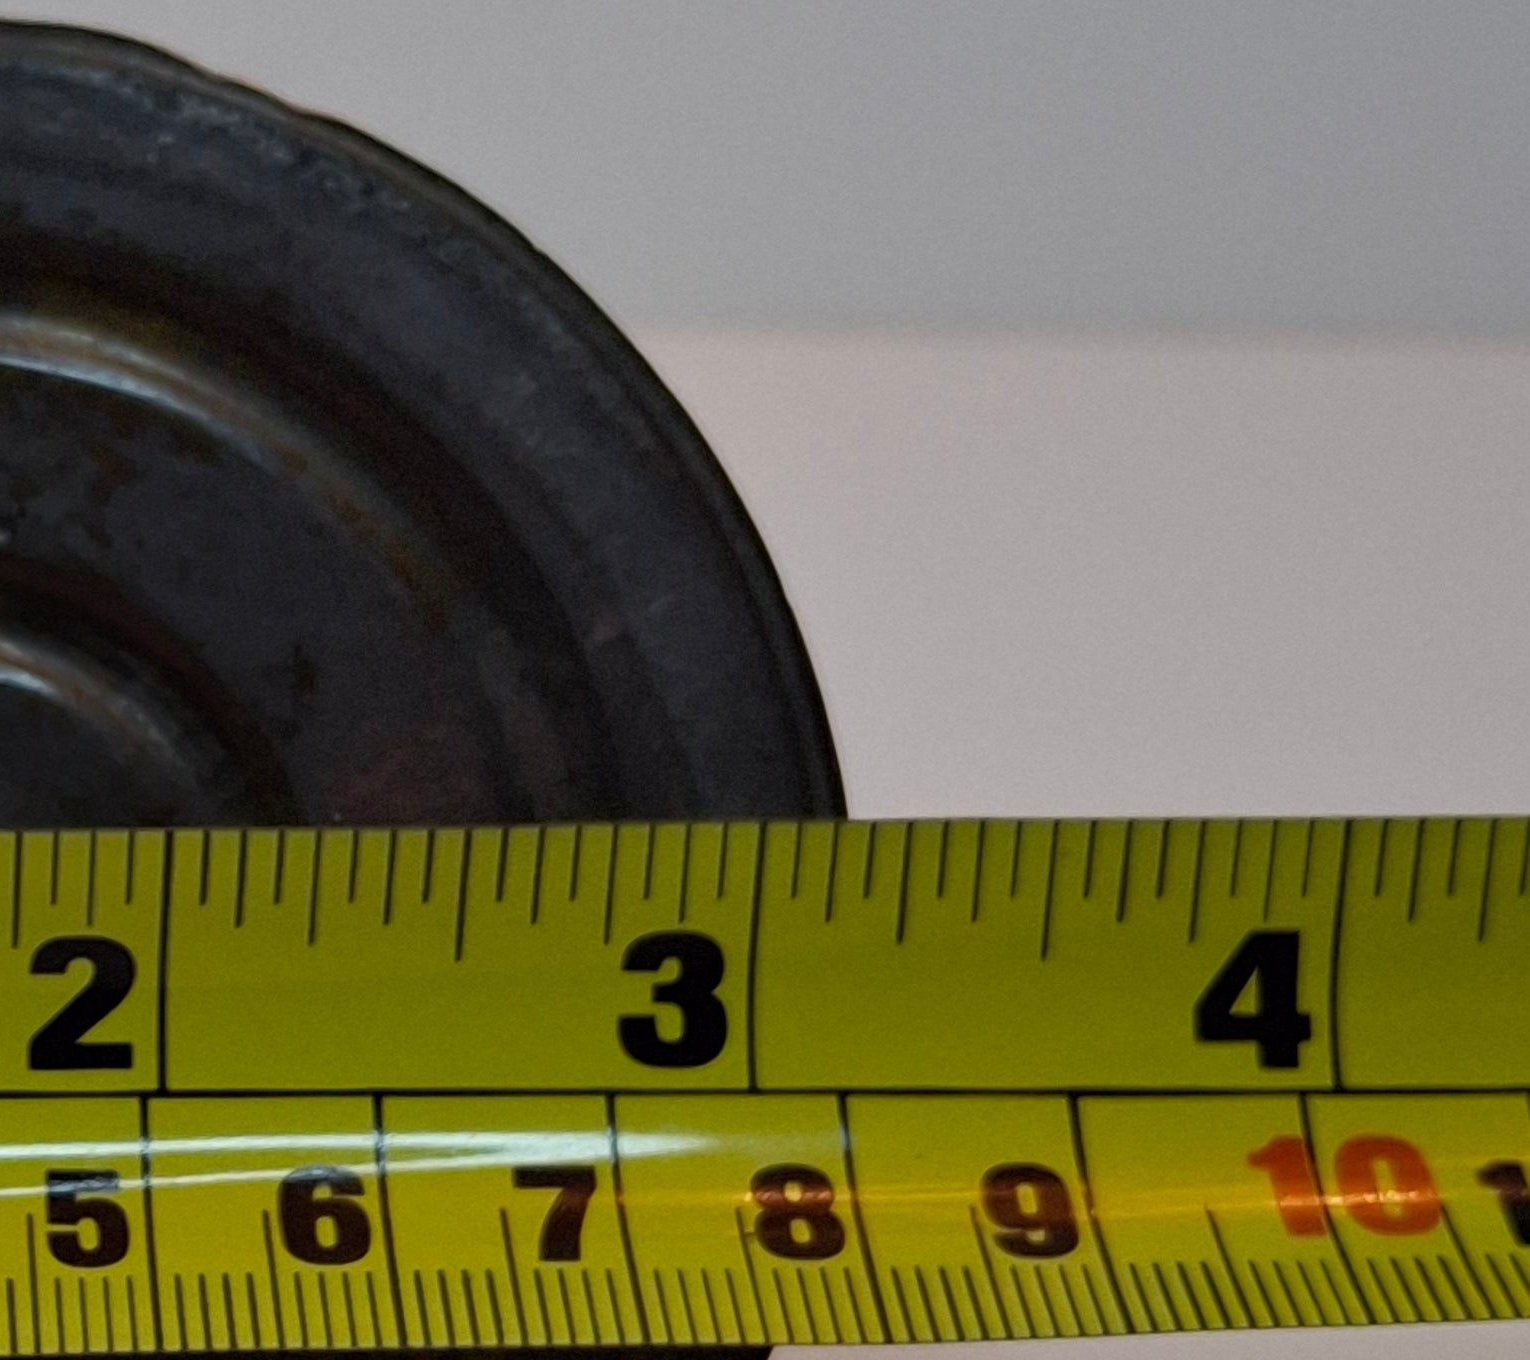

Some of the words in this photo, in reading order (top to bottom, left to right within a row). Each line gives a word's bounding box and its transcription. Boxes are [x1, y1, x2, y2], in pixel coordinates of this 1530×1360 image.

[27, 934, 136, 1070] 2
[617, 930, 728, 1068] 3
[1193, 930, 1312, 1069] 4
[45, 1169, 131, 1268] 5
[278, 1165, 372, 1265] 6
[513, 1165, 598, 1262] 7
[748, 1163, 846, 1261] 8
[980, 1162, 1080, 1259] 9
[1247, 1133, 1444, 1237] 10
